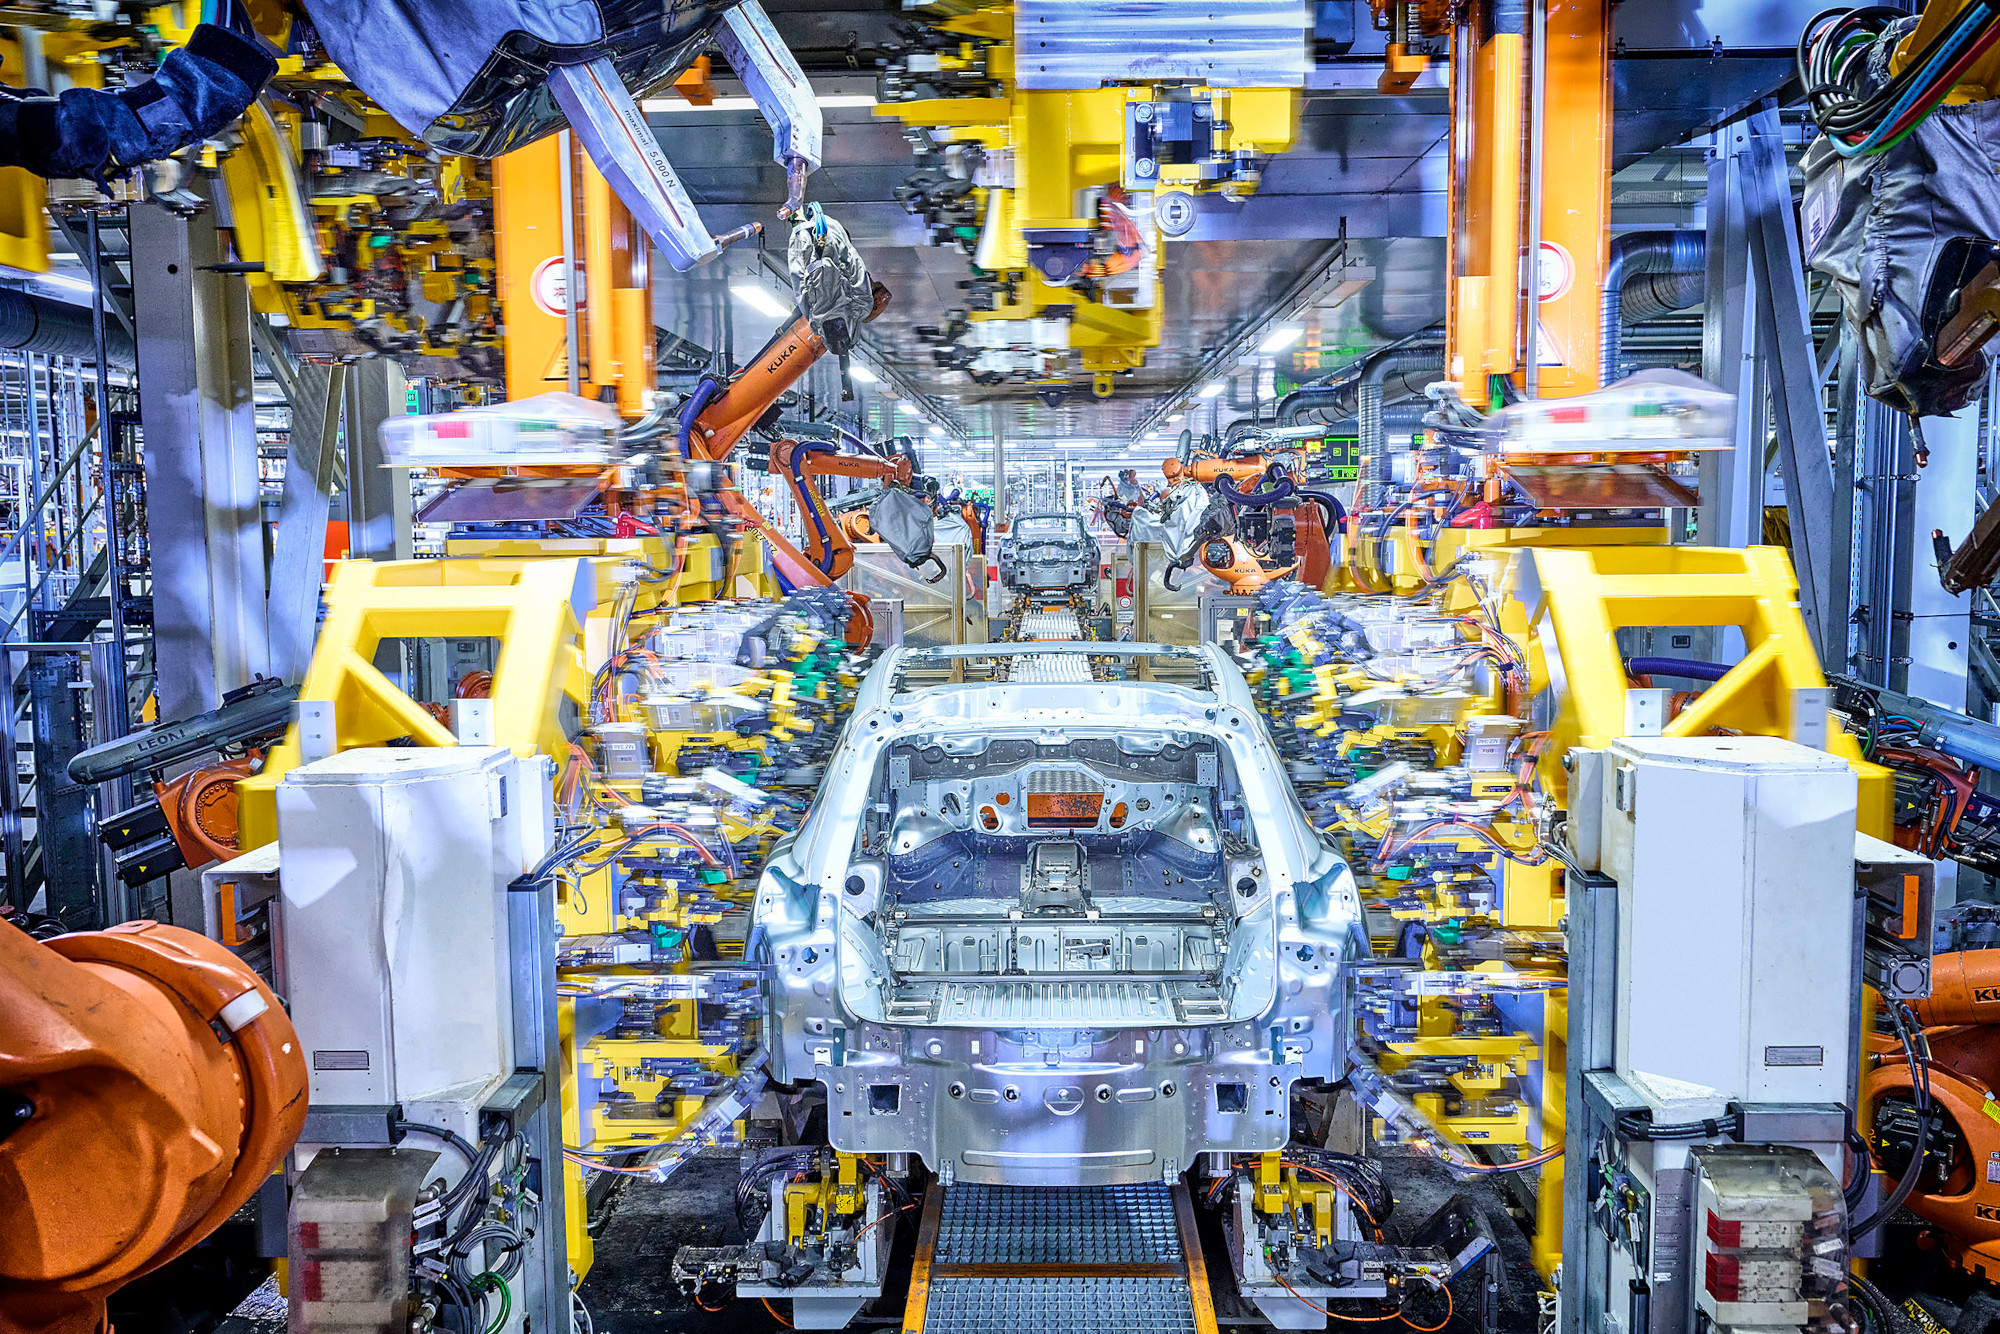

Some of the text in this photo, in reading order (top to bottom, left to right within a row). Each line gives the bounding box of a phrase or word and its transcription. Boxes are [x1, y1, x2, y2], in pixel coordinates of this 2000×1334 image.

[624, 110, 677, 188] maximal 5.000 N
[767, 344, 798, 374] KUKA
[137, 729, 186, 751] LEONI
